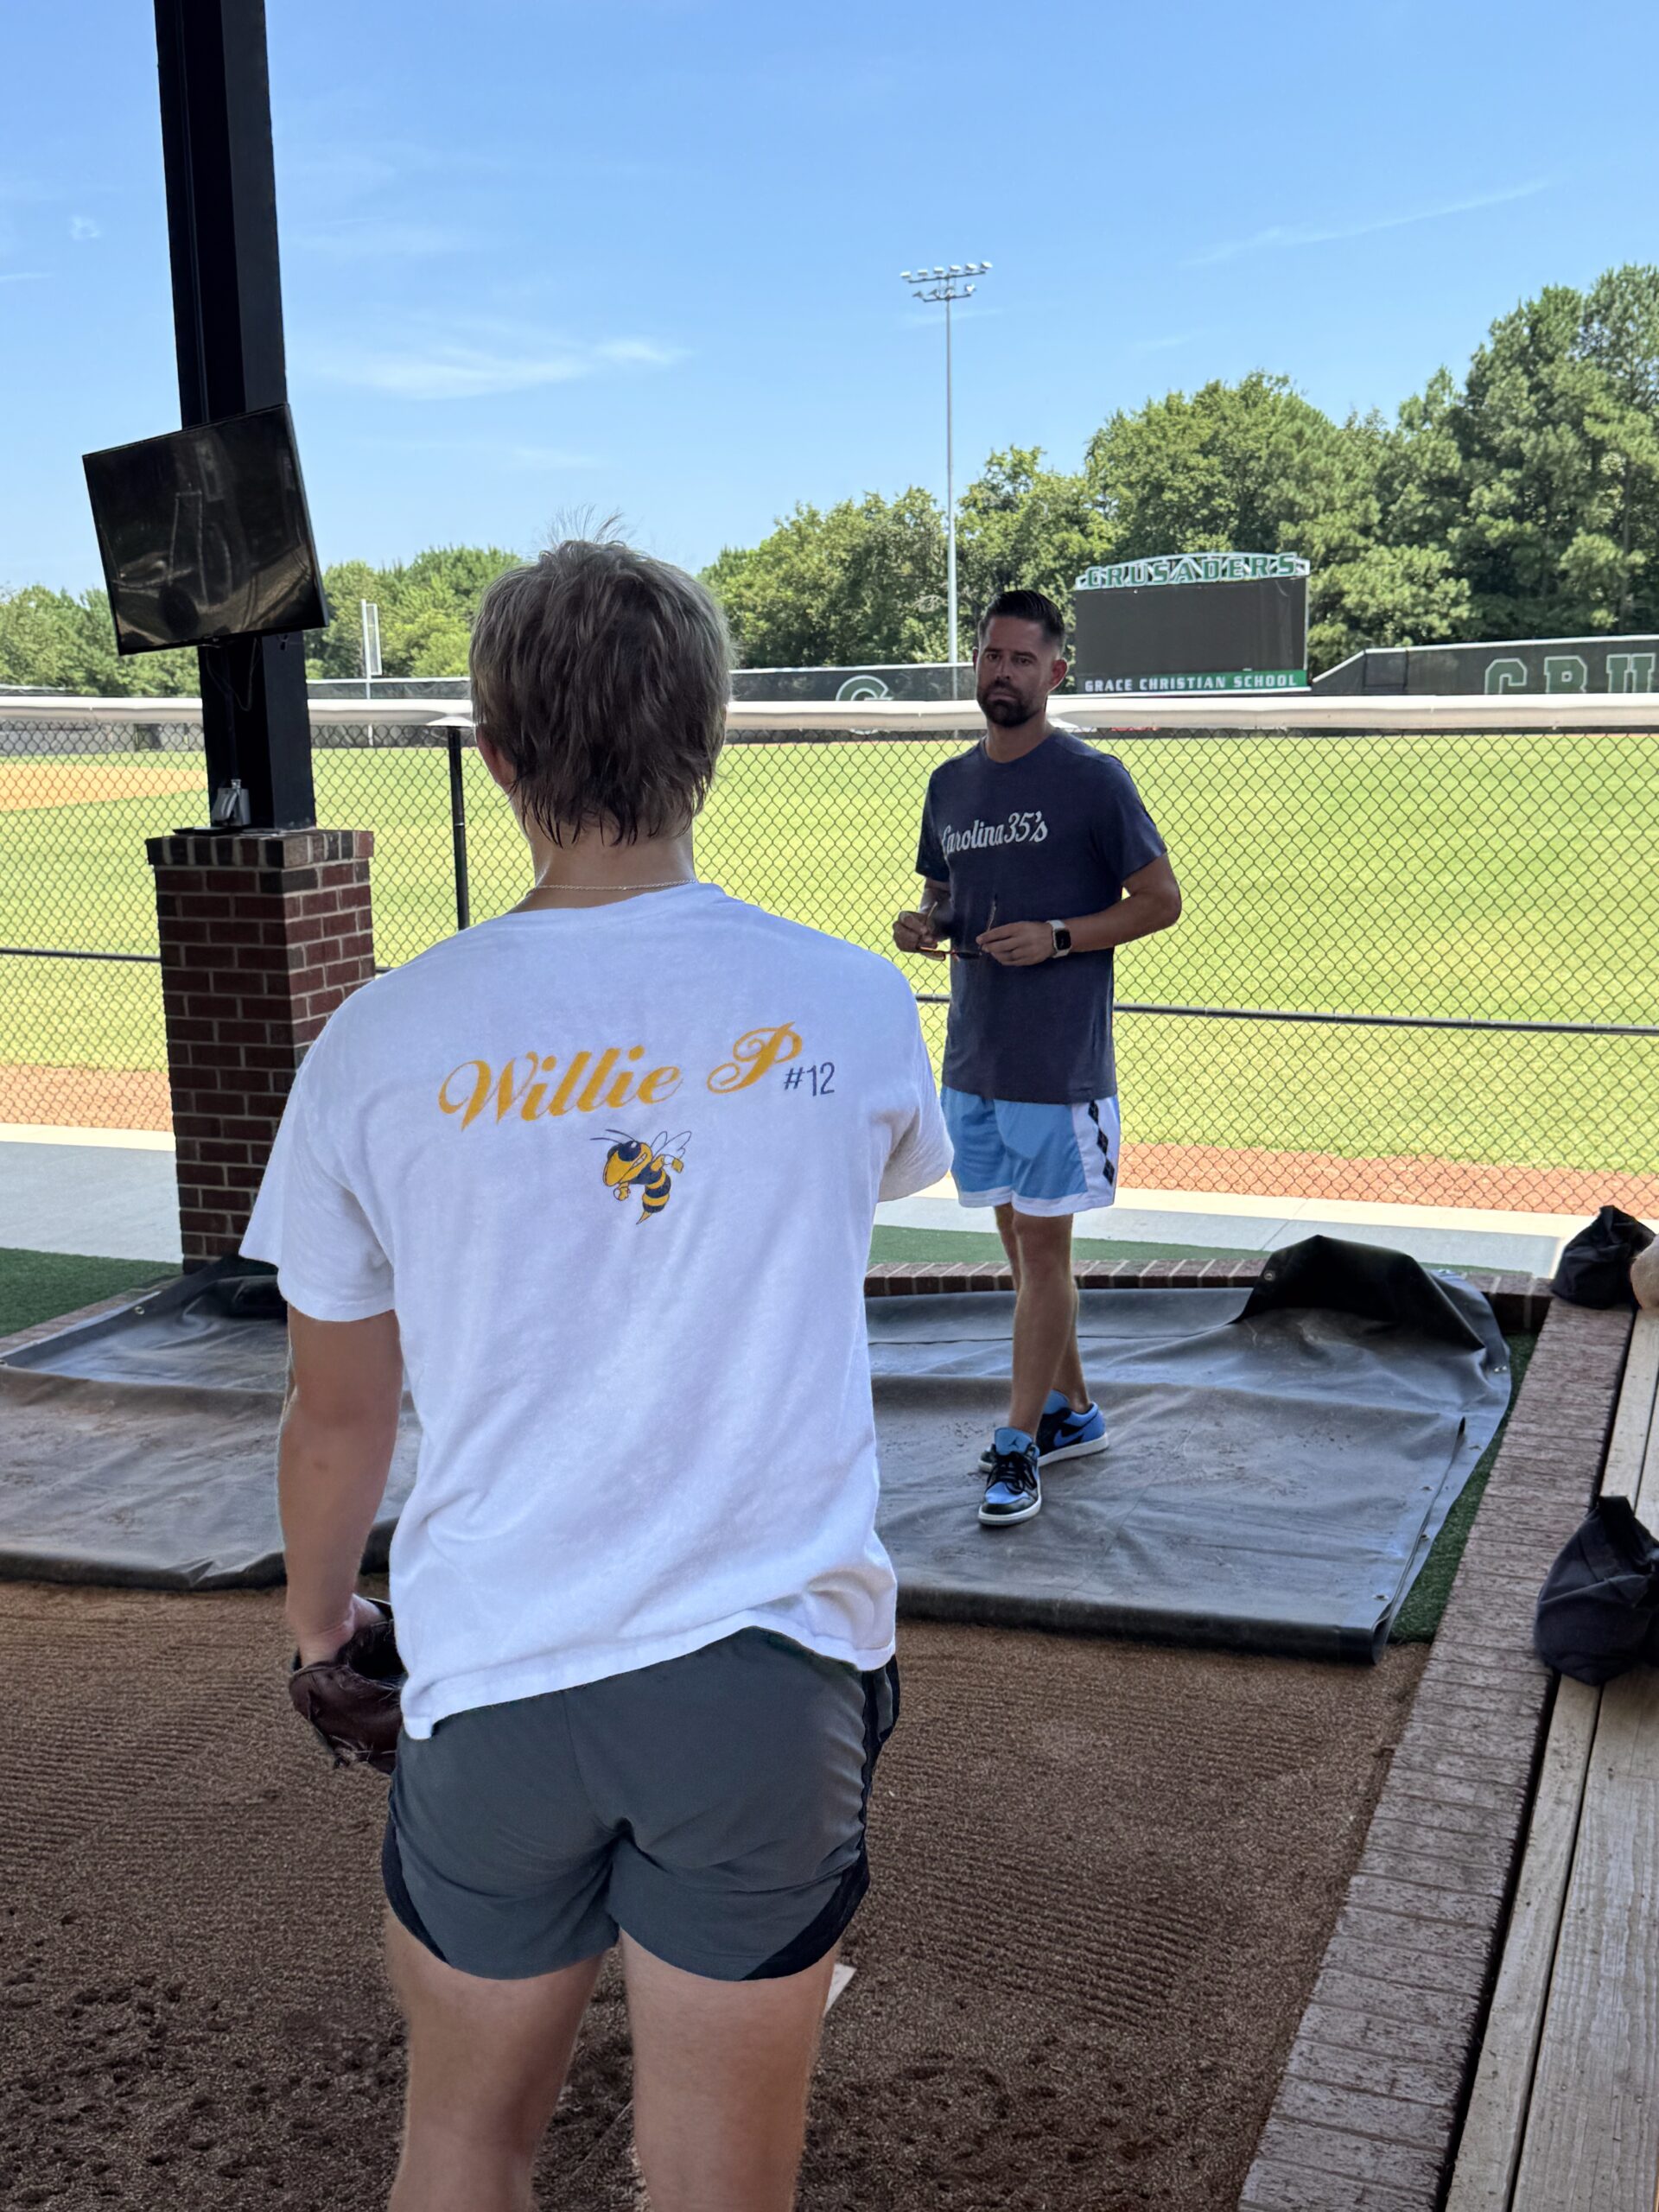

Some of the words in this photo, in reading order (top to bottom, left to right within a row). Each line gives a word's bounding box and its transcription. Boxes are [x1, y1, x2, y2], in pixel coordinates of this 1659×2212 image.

[1085, 552, 1298, 588] CRUSADERS
[1084, 677, 1133, 693] GRACE
[1139, 675, 1226, 691] CHRISTIAN
[1233, 673, 1298, 689] SCHOOL
[438, 1044, 684, 1132] Willie
[707, 1020, 804, 1095] P
[783, 1060, 836, 1097] #12
